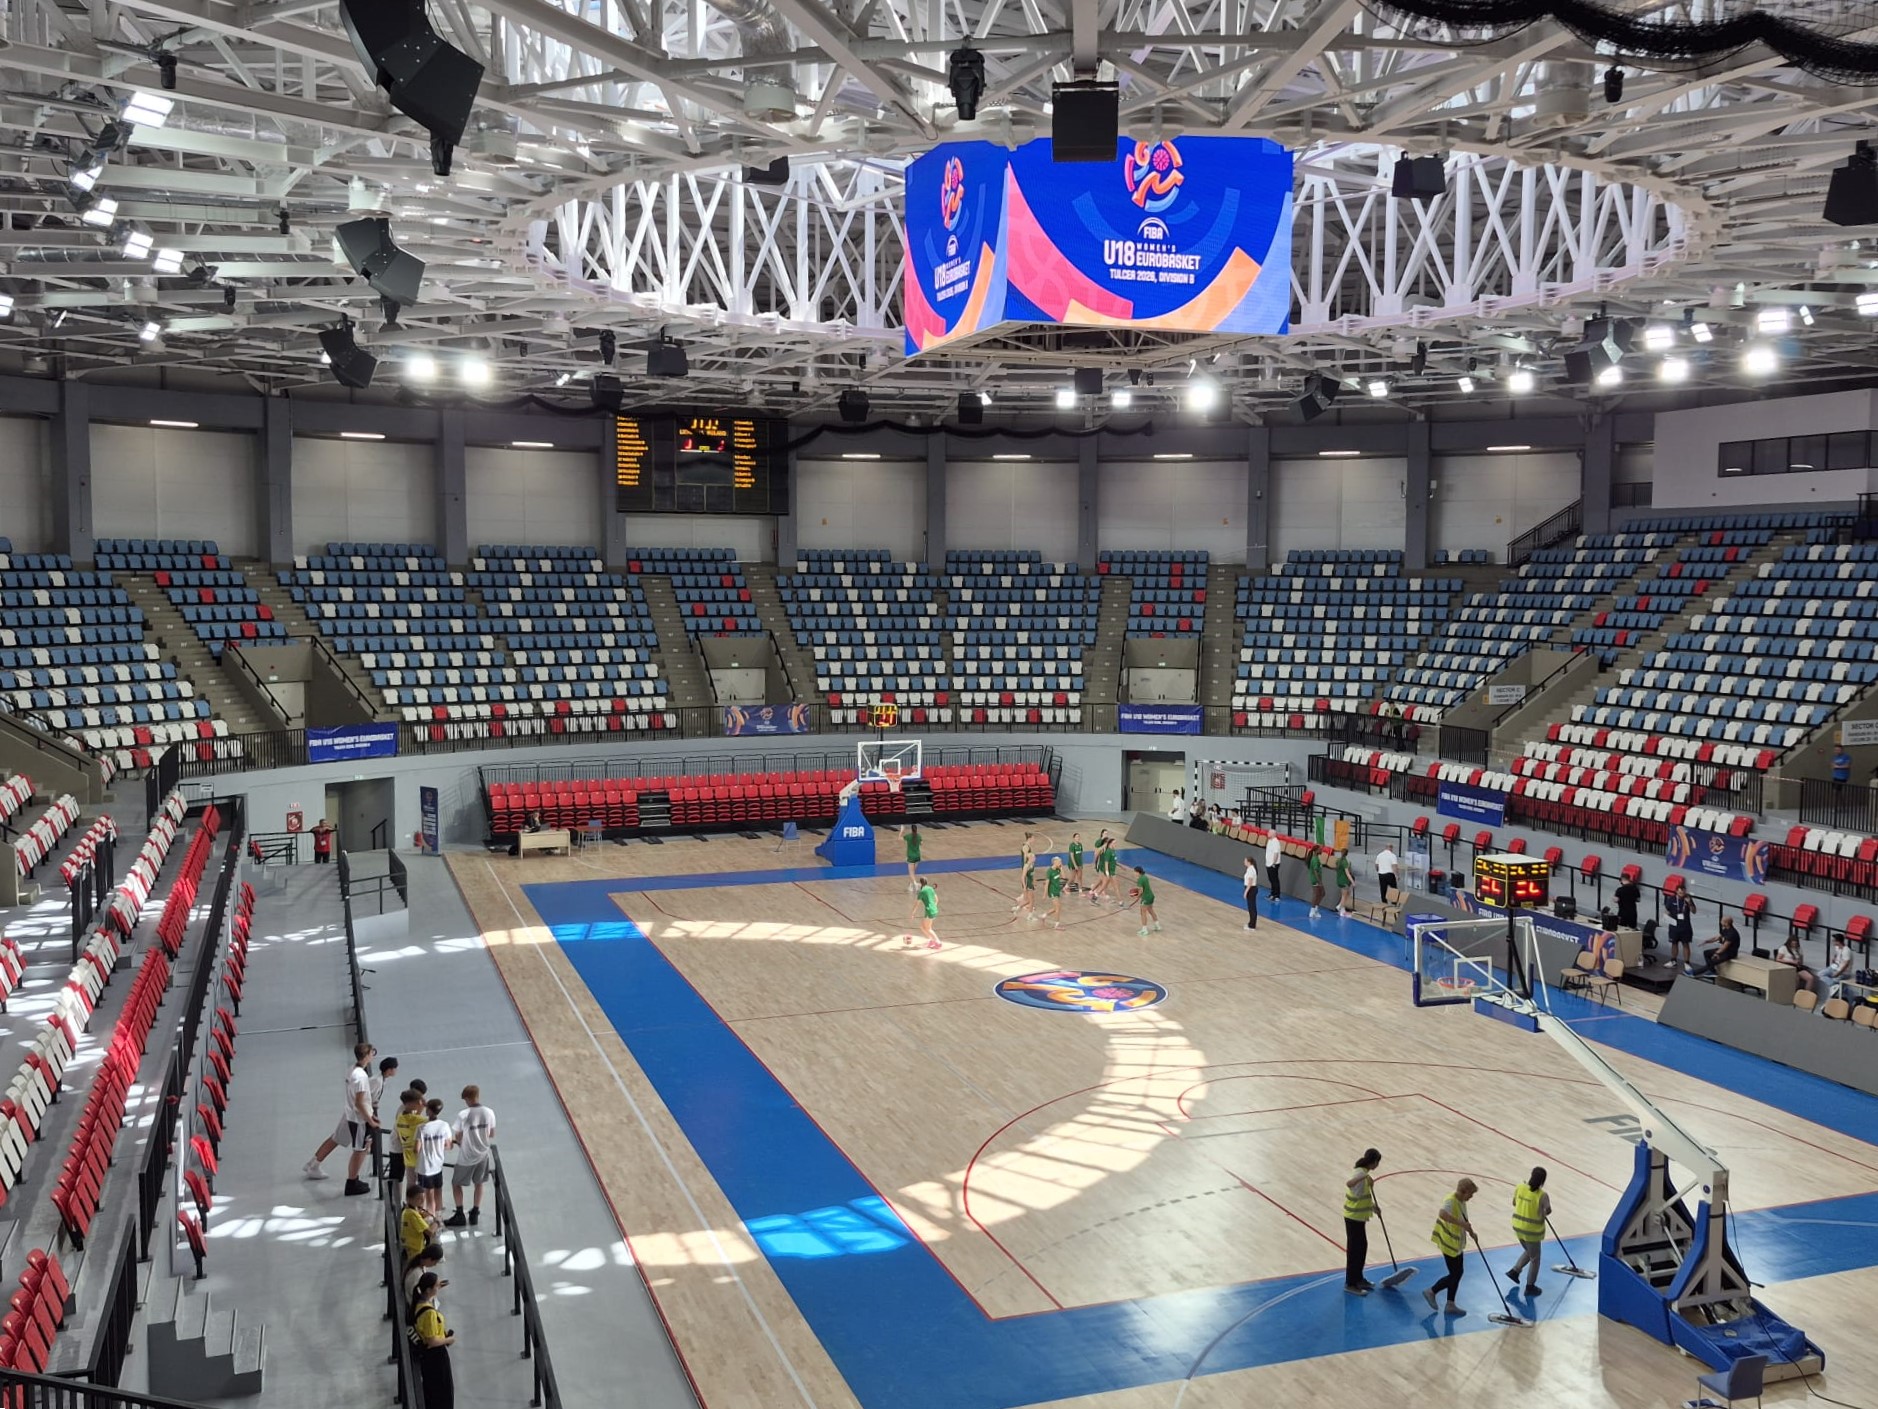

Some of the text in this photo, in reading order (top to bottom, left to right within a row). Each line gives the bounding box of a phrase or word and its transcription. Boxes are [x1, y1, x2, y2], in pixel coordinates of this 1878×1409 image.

[1144, 226, 1163, 240] FIBA
[1104, 240, 1176, 266] U18 WOMEN'S
[1136, 252, 1201, 270] EUROBASKET
[1110, 268, 1136, 280] TULCEA
[1159, 272, 1188, 283] DIVISION
[843, 827, 865, 837] FIBA
